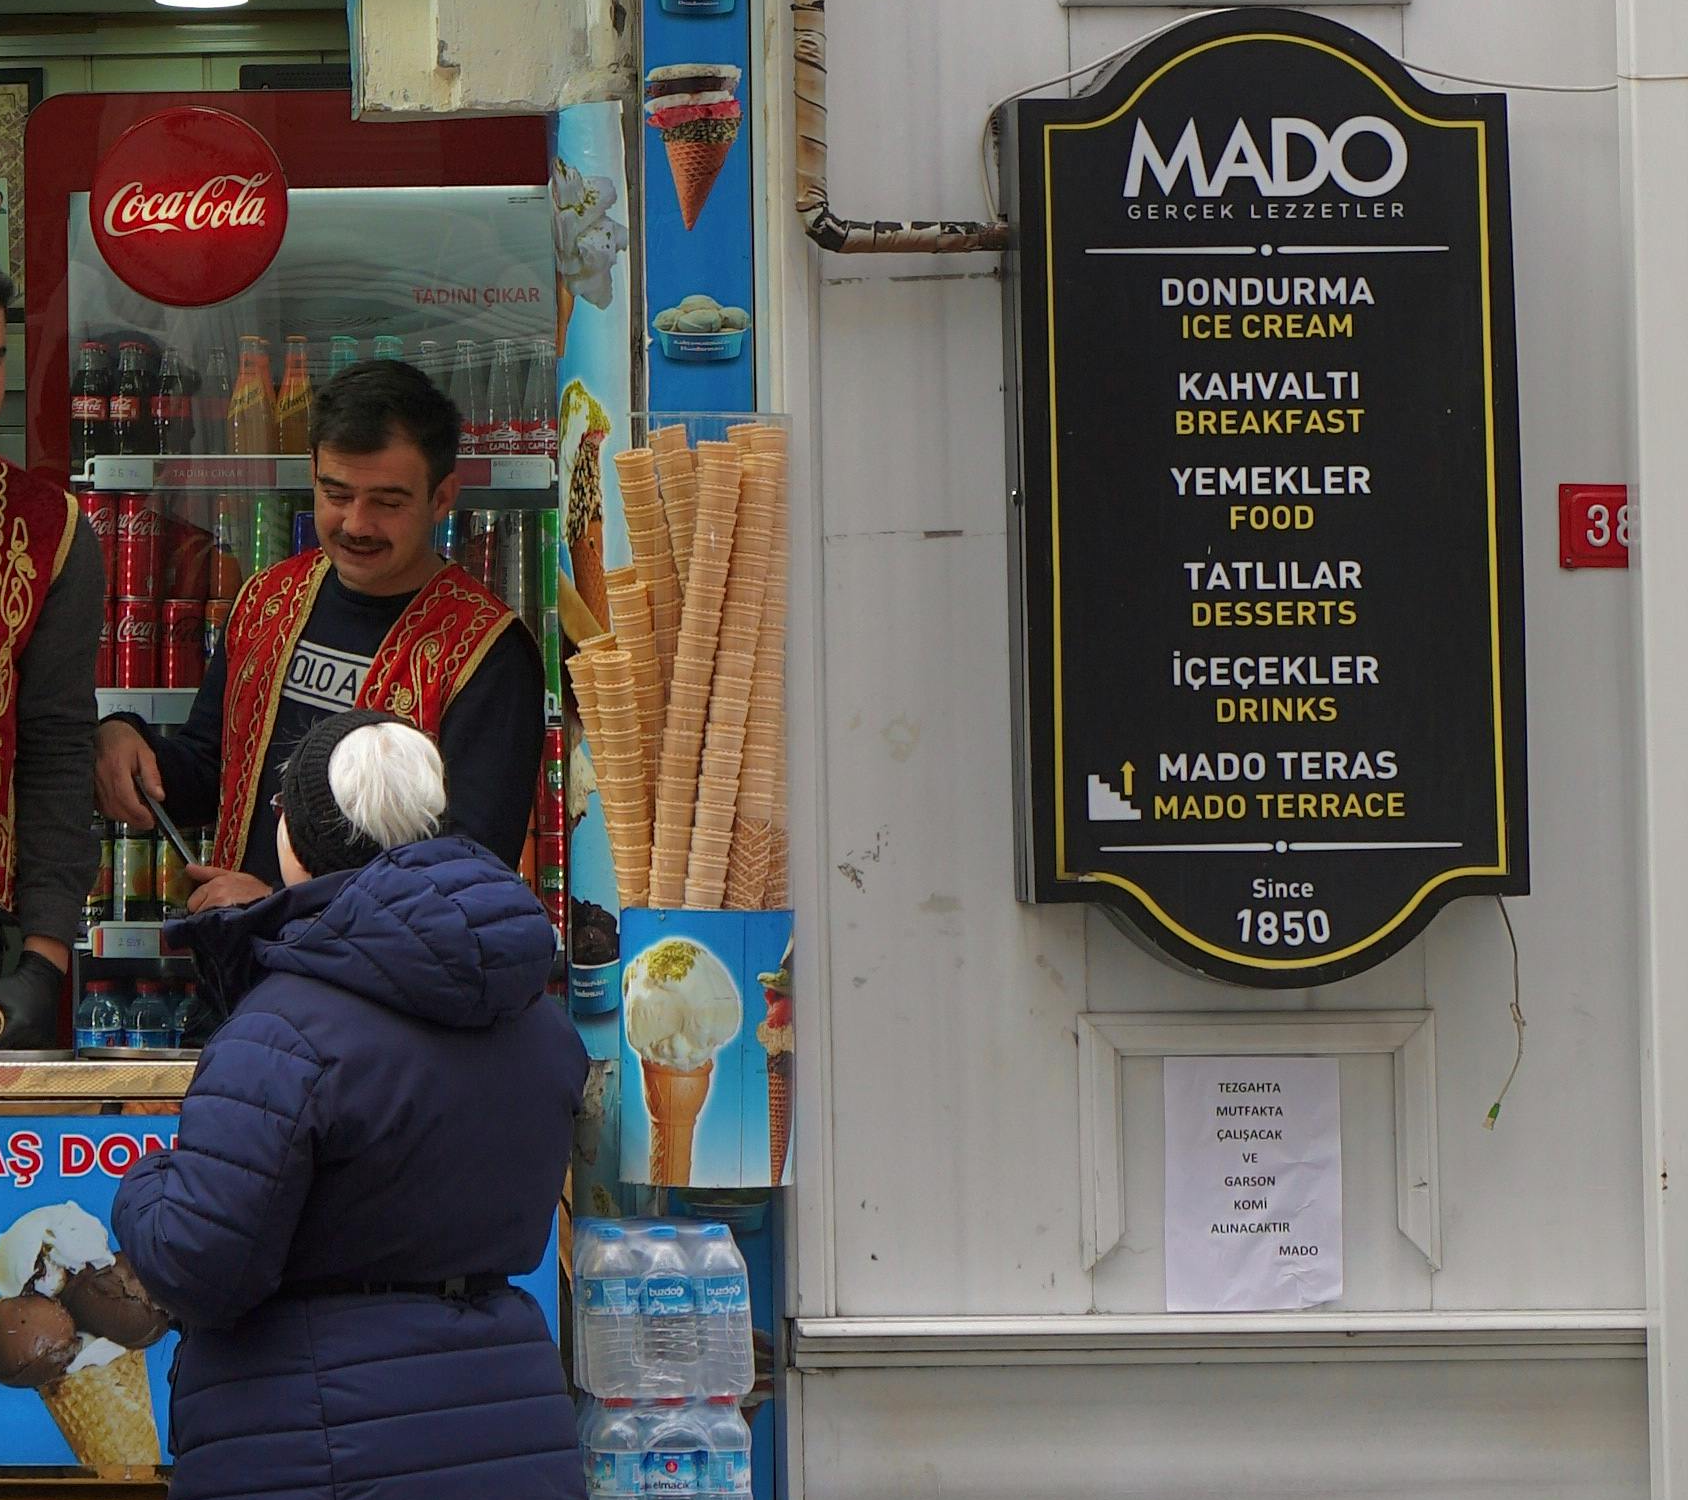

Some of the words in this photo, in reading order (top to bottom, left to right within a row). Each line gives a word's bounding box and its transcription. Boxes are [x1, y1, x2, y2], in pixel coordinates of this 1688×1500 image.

[1122, 114, 1408, 198] MADO
[103, 172, 273, 237] Coca-Cola
[1127, 203, 1235, 222] GERÇEK
[1251, 202, 1405, 220] LEZZETLER
[412, 288, 478, 306] TADINI
[482, 287, 541, 308] ÇIKAR
[1160, 276, 1375, 308] DONDURMA
[1181, 314, 1231, 340] ICE
[1242, 313, 1354, 340] CREAM
[1179, 371, 1360, 402] KAHVALTI
[1175, 409, 1365, 436] BREAKFAST
[1170, 466, 1371, 496] YEMEKLER
[1229, 505, 1315, 530] FOOD
[1183, 561, 1362, 591] TATLILAR
[1191, 601, 1357, 627] DESSERTS
[290, 653, 336, 692] OLO
[1172, 651, 1379, 690] İÇEÇEKLER
[1215, 697, 1338, 723] DRINKS
[1158, 752, 1266, 781] MADO
[1277, 751, 1399, 780] TERAS
[1154, 795, 1247, 820] MADO
[1257, 793, 1406, 819] TERRACE
[1252, 878, 1314, 900] Since
[1235, 909, 1331, 946] 1850
[1218, 1082, 1281, 1093] TEZGAHTA
[1216, 1106, 1283, 1117] MUTFAKTA
[1217, 1129, 1282, 1142] ÇALIŞACAK
[1242, 1153, 1258, 1164] VE
[1224, 1176, 1276, 1187] GARSON
[1233, 1197, 1267, 1210] KOMİ
[1211, 1222, 1290, 1234] ALINACAKTIR
[1279, 1245, 1318, 1257] MADO
